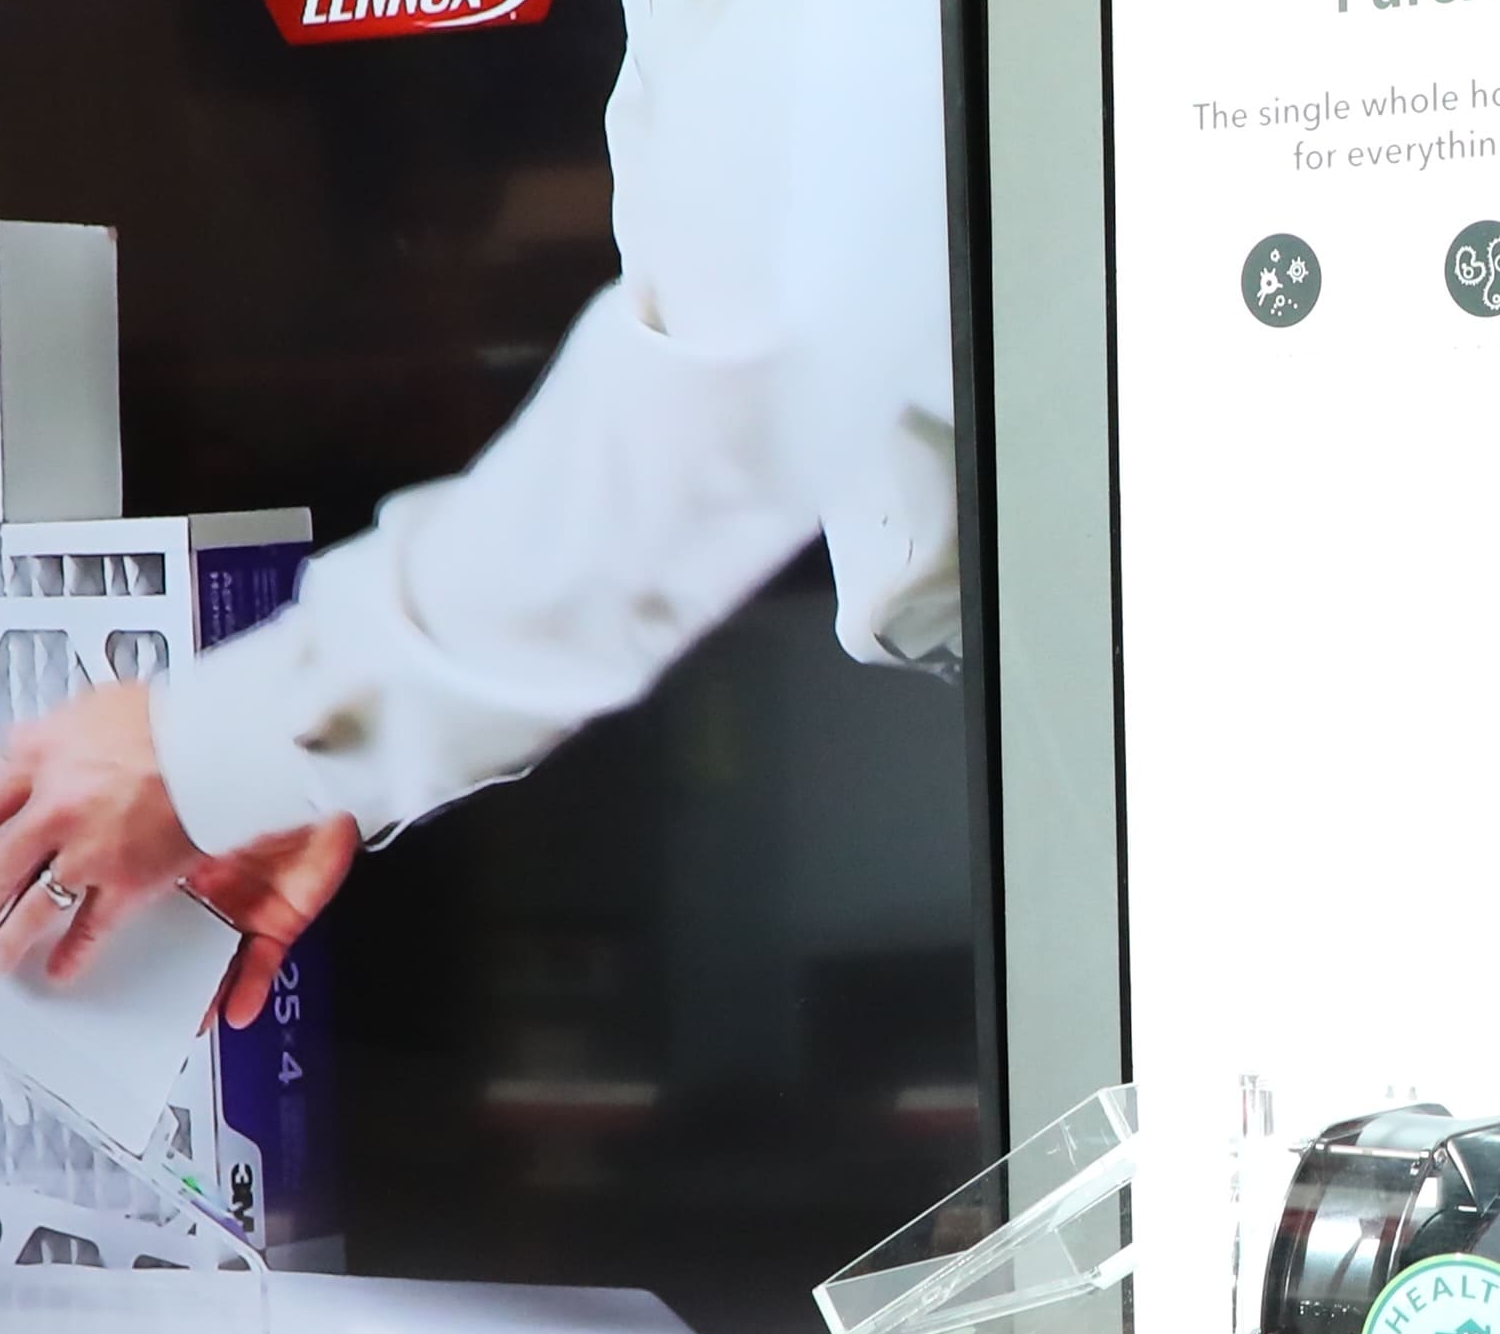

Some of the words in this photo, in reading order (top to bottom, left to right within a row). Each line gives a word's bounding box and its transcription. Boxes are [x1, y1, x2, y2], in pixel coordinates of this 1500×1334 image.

[1193, 101, 1247, 131] The
[1259, 91, 1351, 132] single
[1361, 81, 1458, 118] whole
[1293, 140, 1337, 171] for
